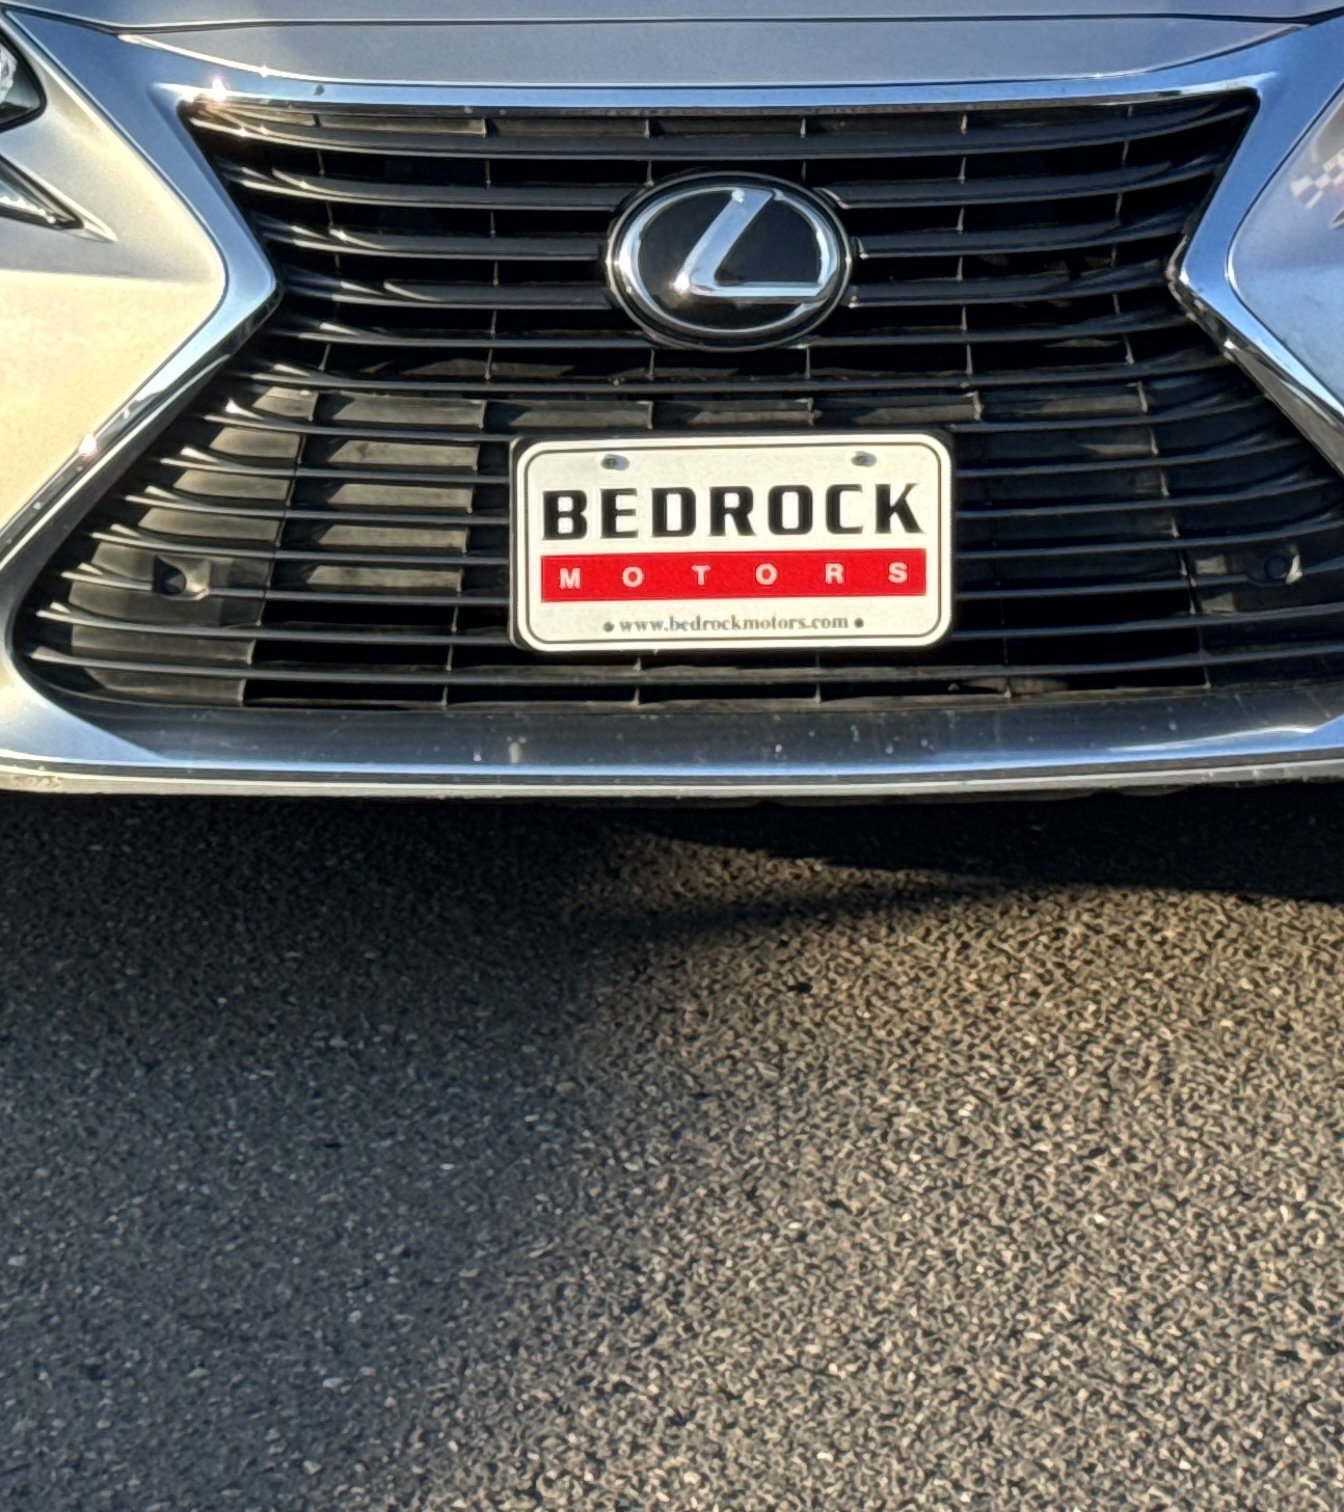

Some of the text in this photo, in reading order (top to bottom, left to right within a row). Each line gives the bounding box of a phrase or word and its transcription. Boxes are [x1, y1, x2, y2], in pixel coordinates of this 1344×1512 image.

[542, 483, 923, 541] BEDROCK
[559, 562, 908, 590] MOTORS
[619, 614, 849, 633] www.bedrockmotors.com
